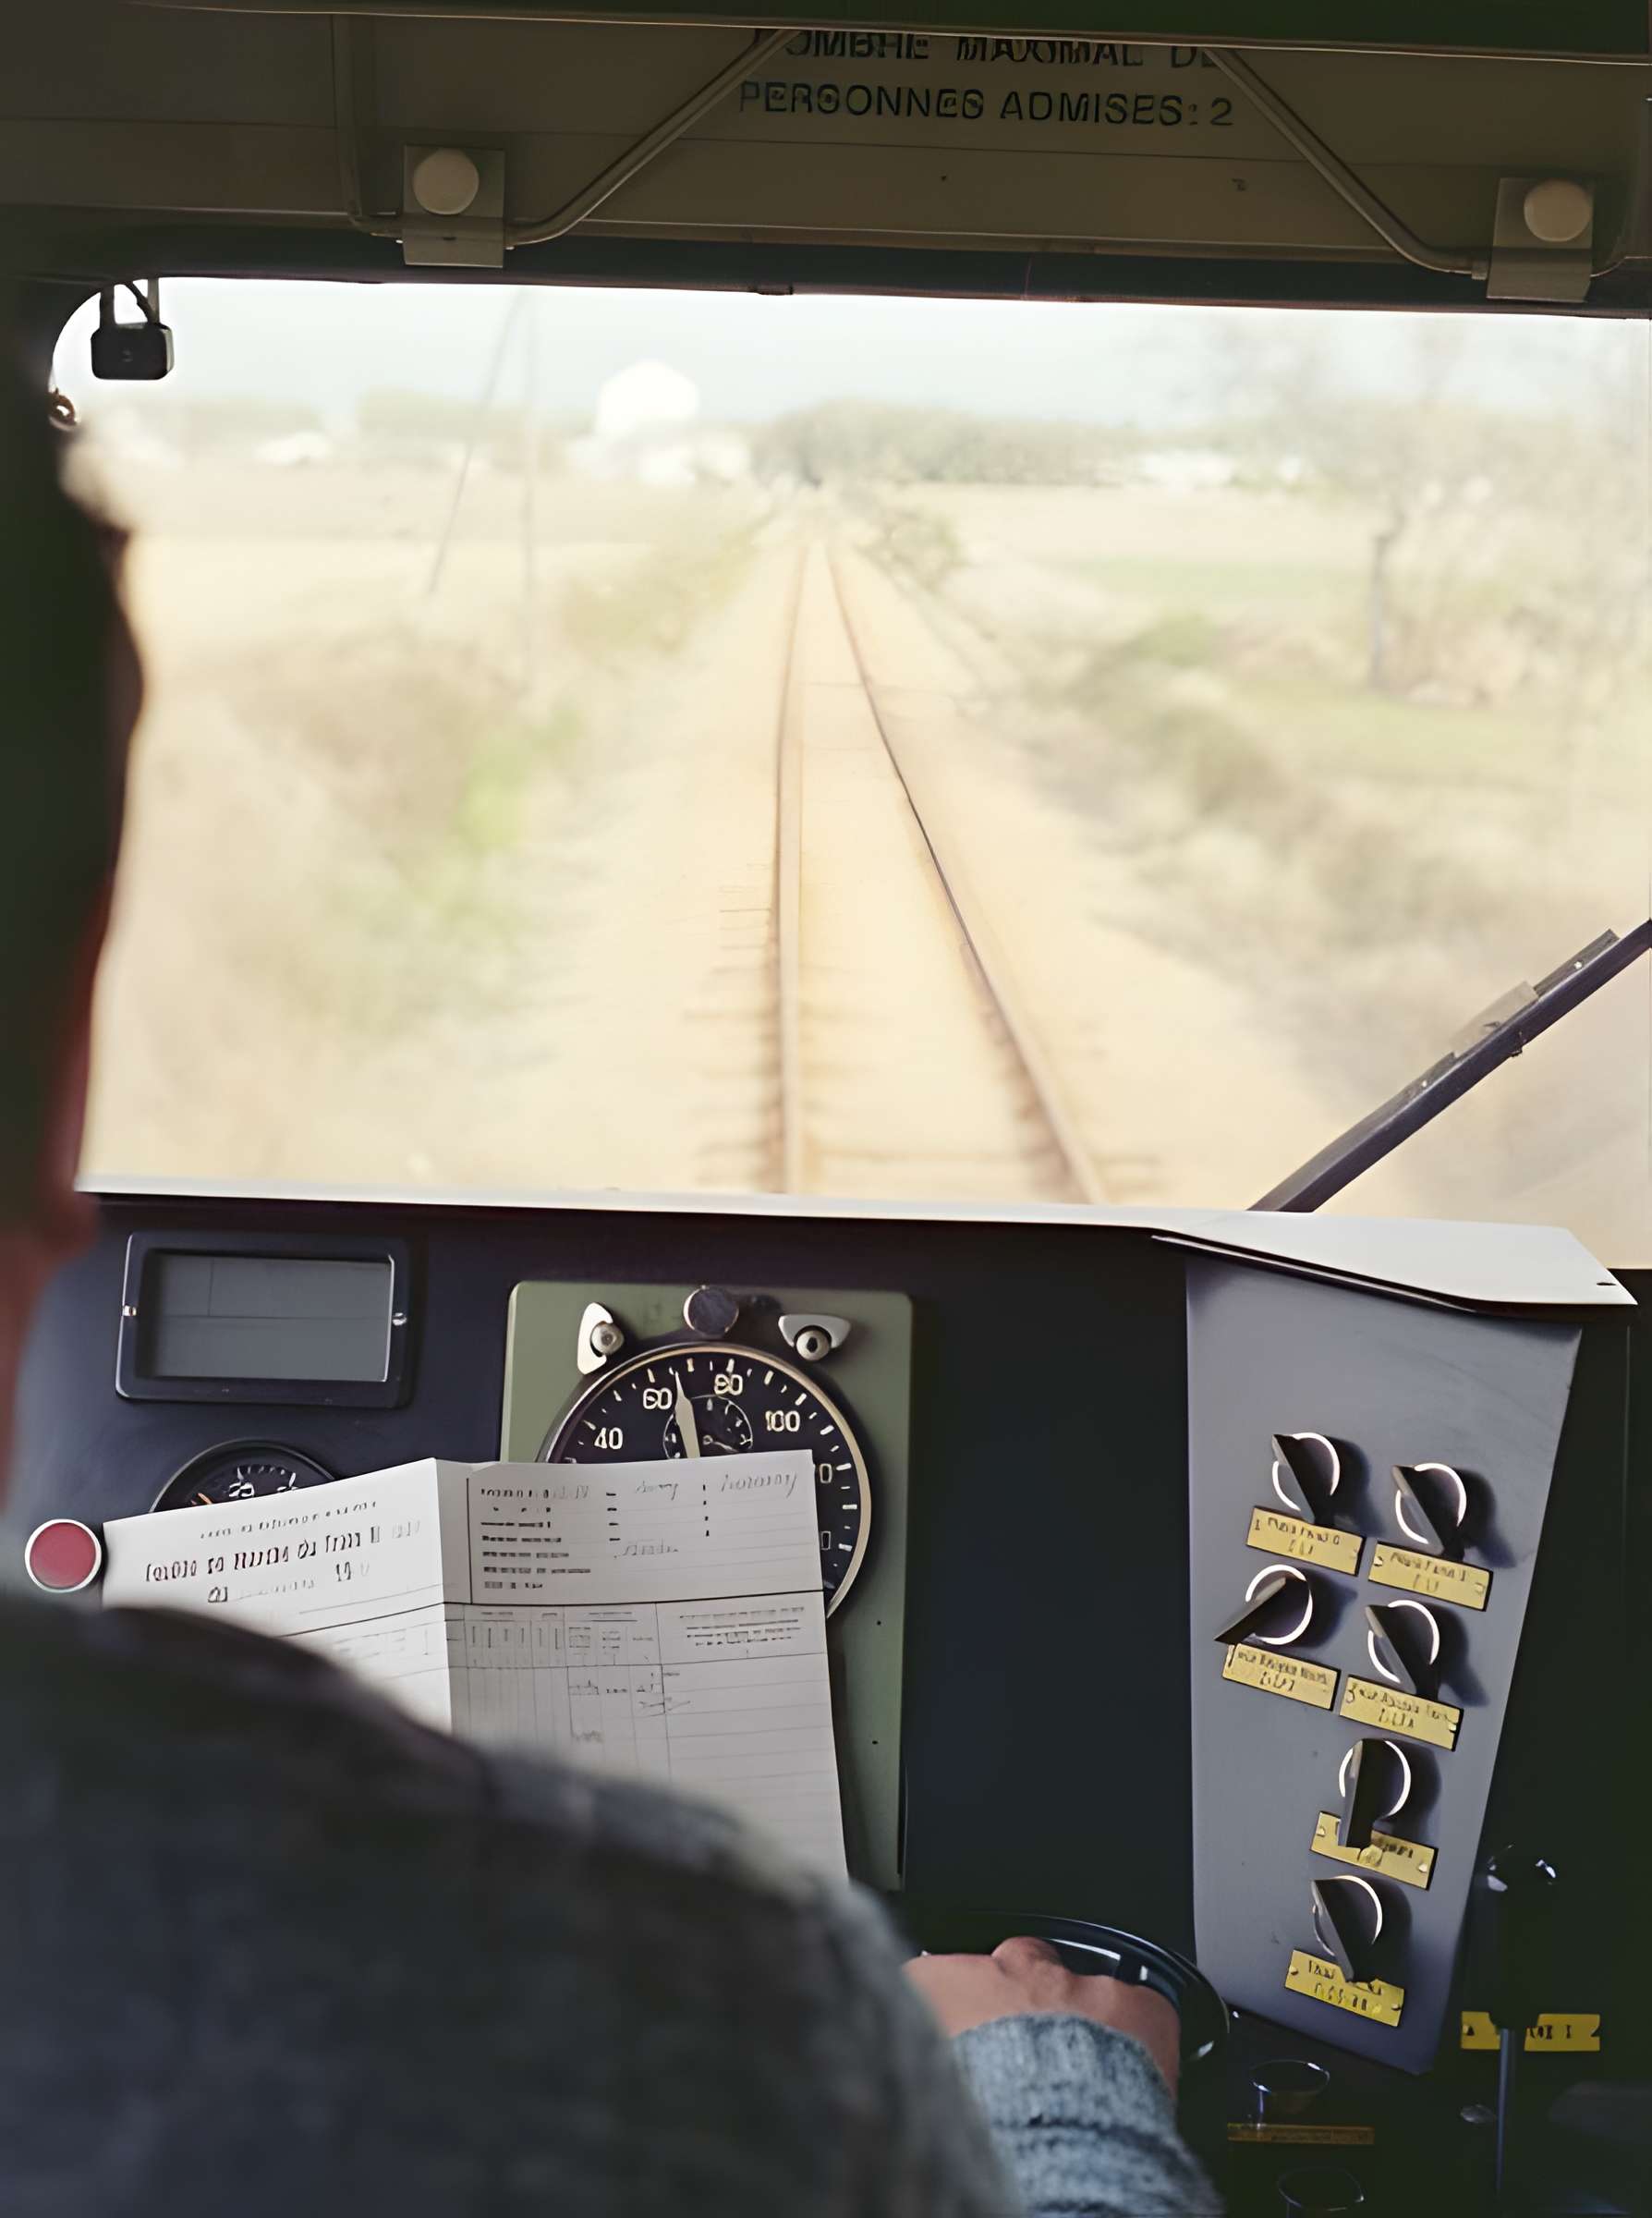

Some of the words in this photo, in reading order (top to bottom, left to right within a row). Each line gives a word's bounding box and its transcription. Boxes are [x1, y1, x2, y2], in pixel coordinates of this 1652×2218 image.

[739, 81, 984, 120] PERSONNES
[1210, 97, 1234, 126] 2
[766, 1410, 800, 1432] 100
[594, 1427, 623, 1450] 40
